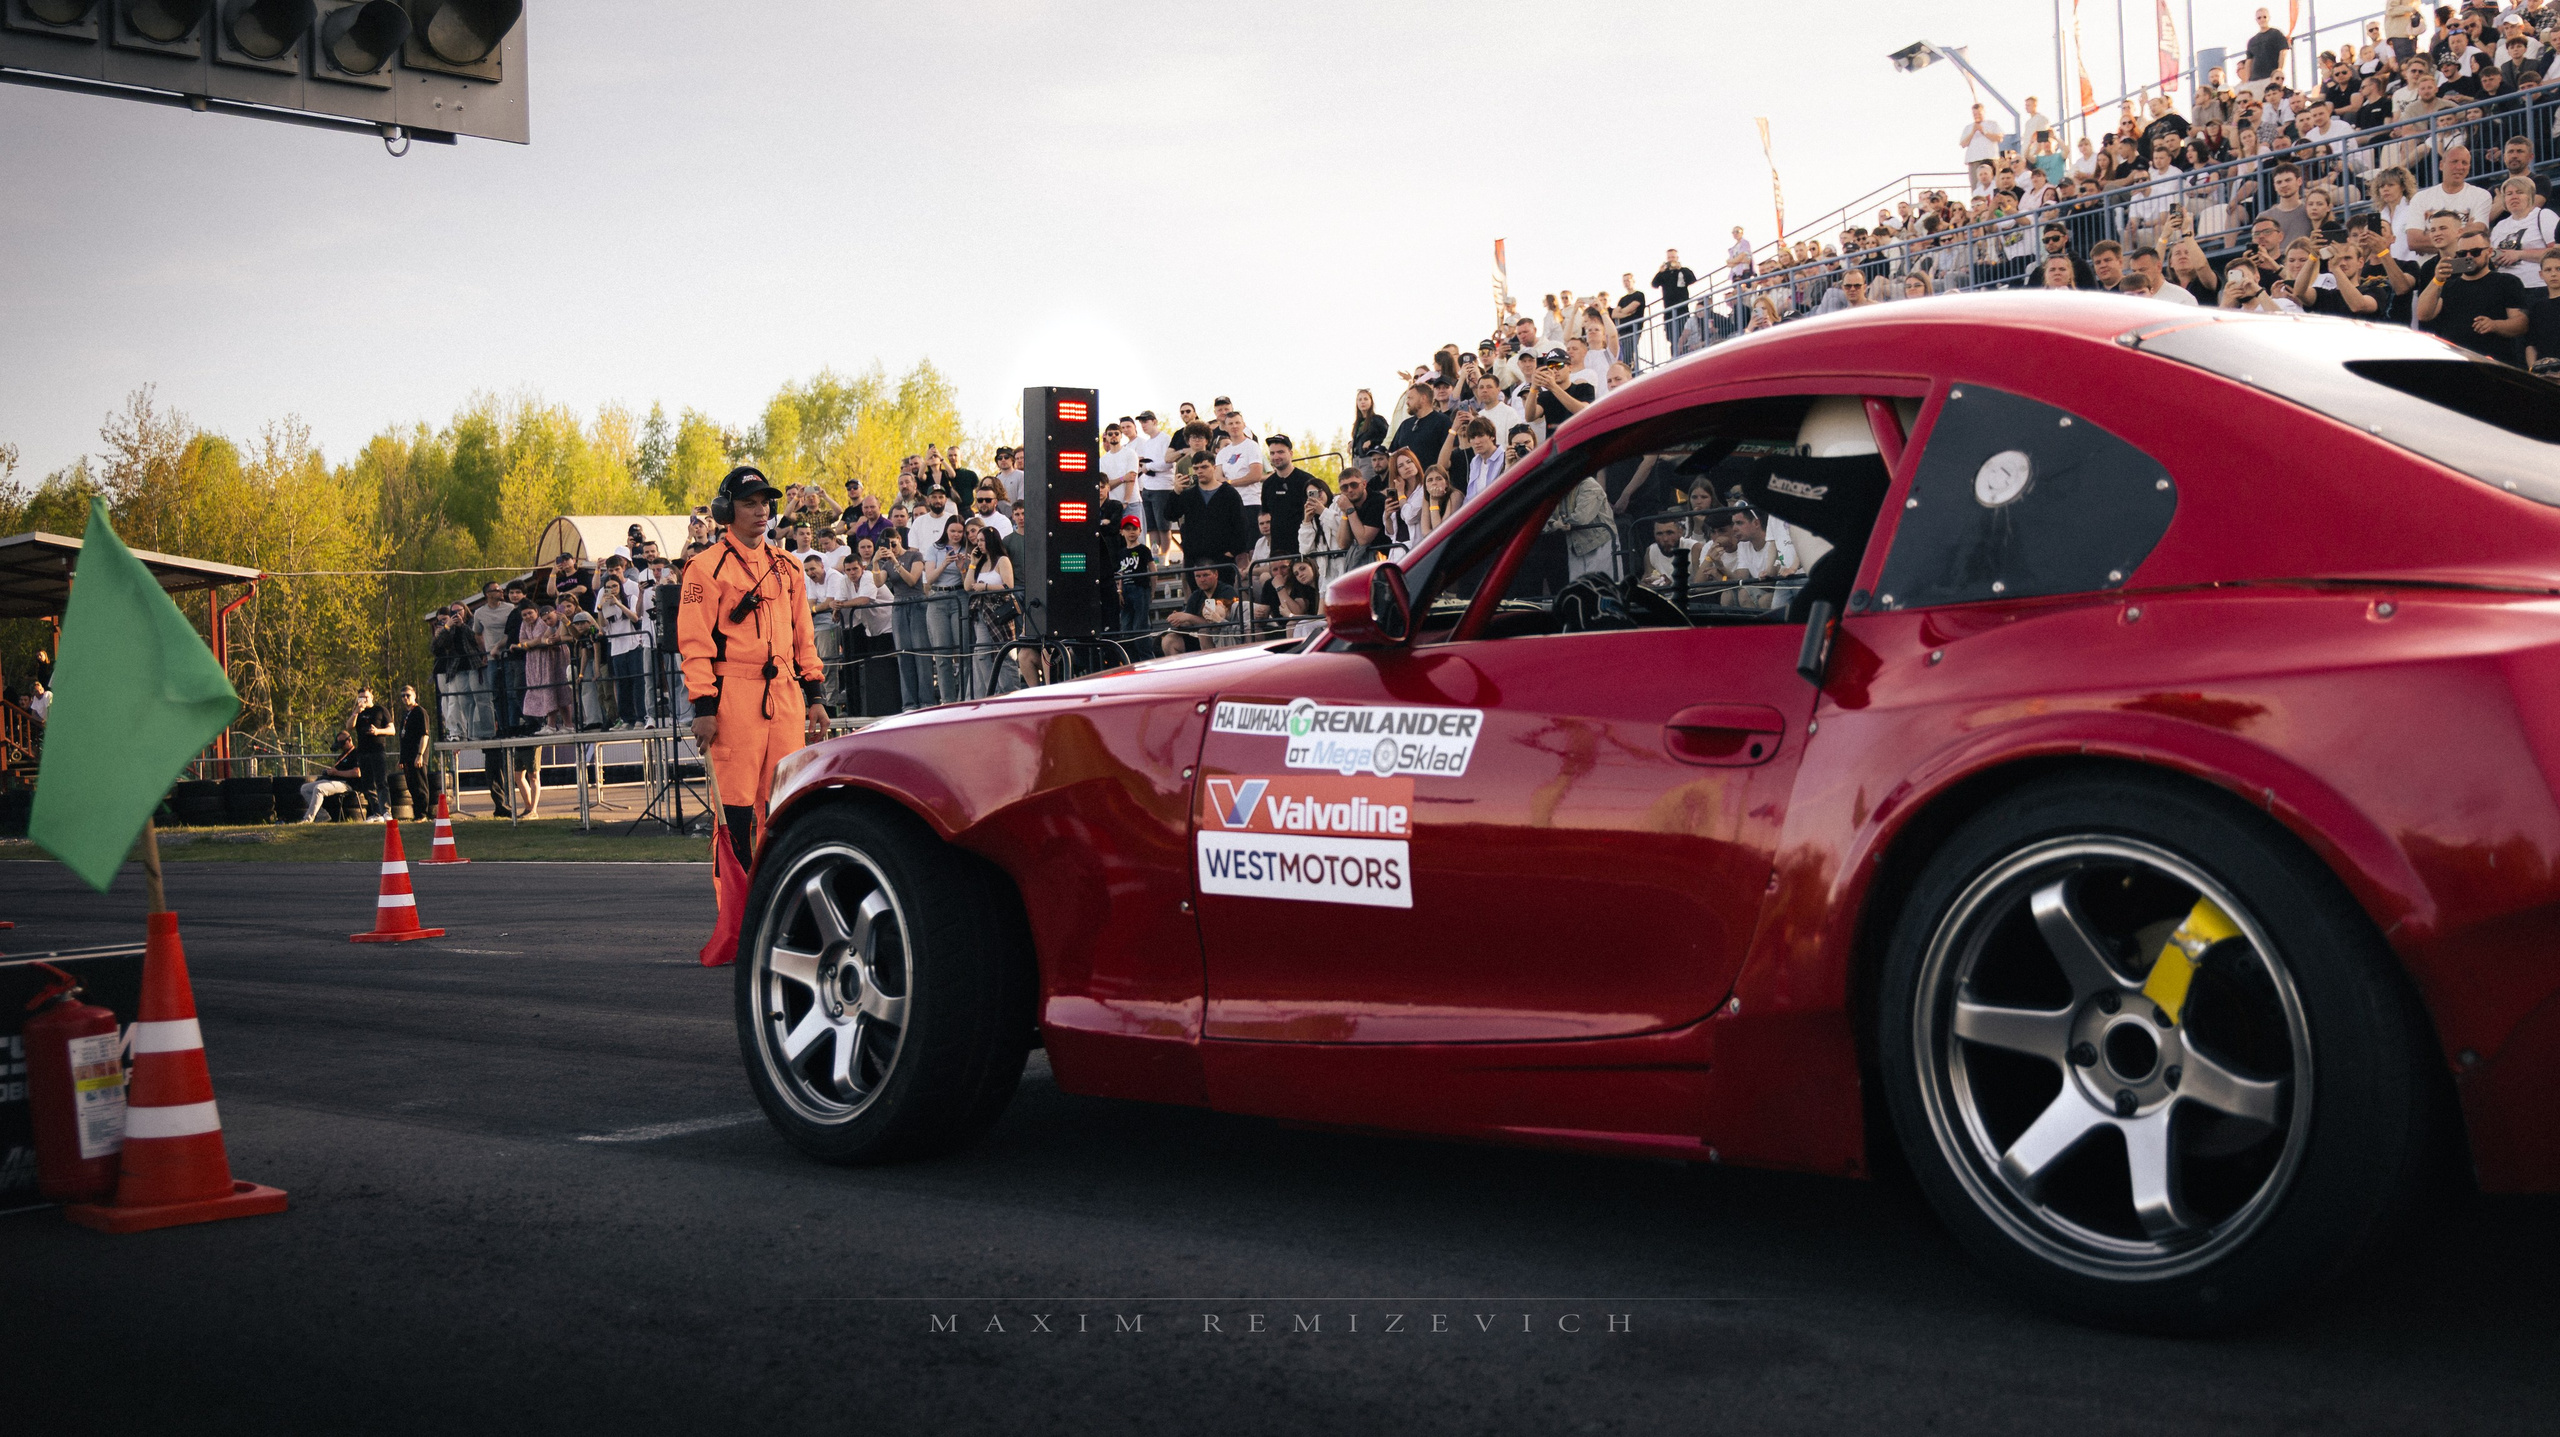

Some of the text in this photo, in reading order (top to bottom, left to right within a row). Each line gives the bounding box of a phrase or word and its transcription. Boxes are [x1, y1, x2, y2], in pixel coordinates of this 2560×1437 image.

[1216, 703, 1478, 737] НА ШИНАХ GRENLANDER
[1267, 795, 1408, 834] Valvoline
[1206, 848, 1402, 890] WESTMOTORS
